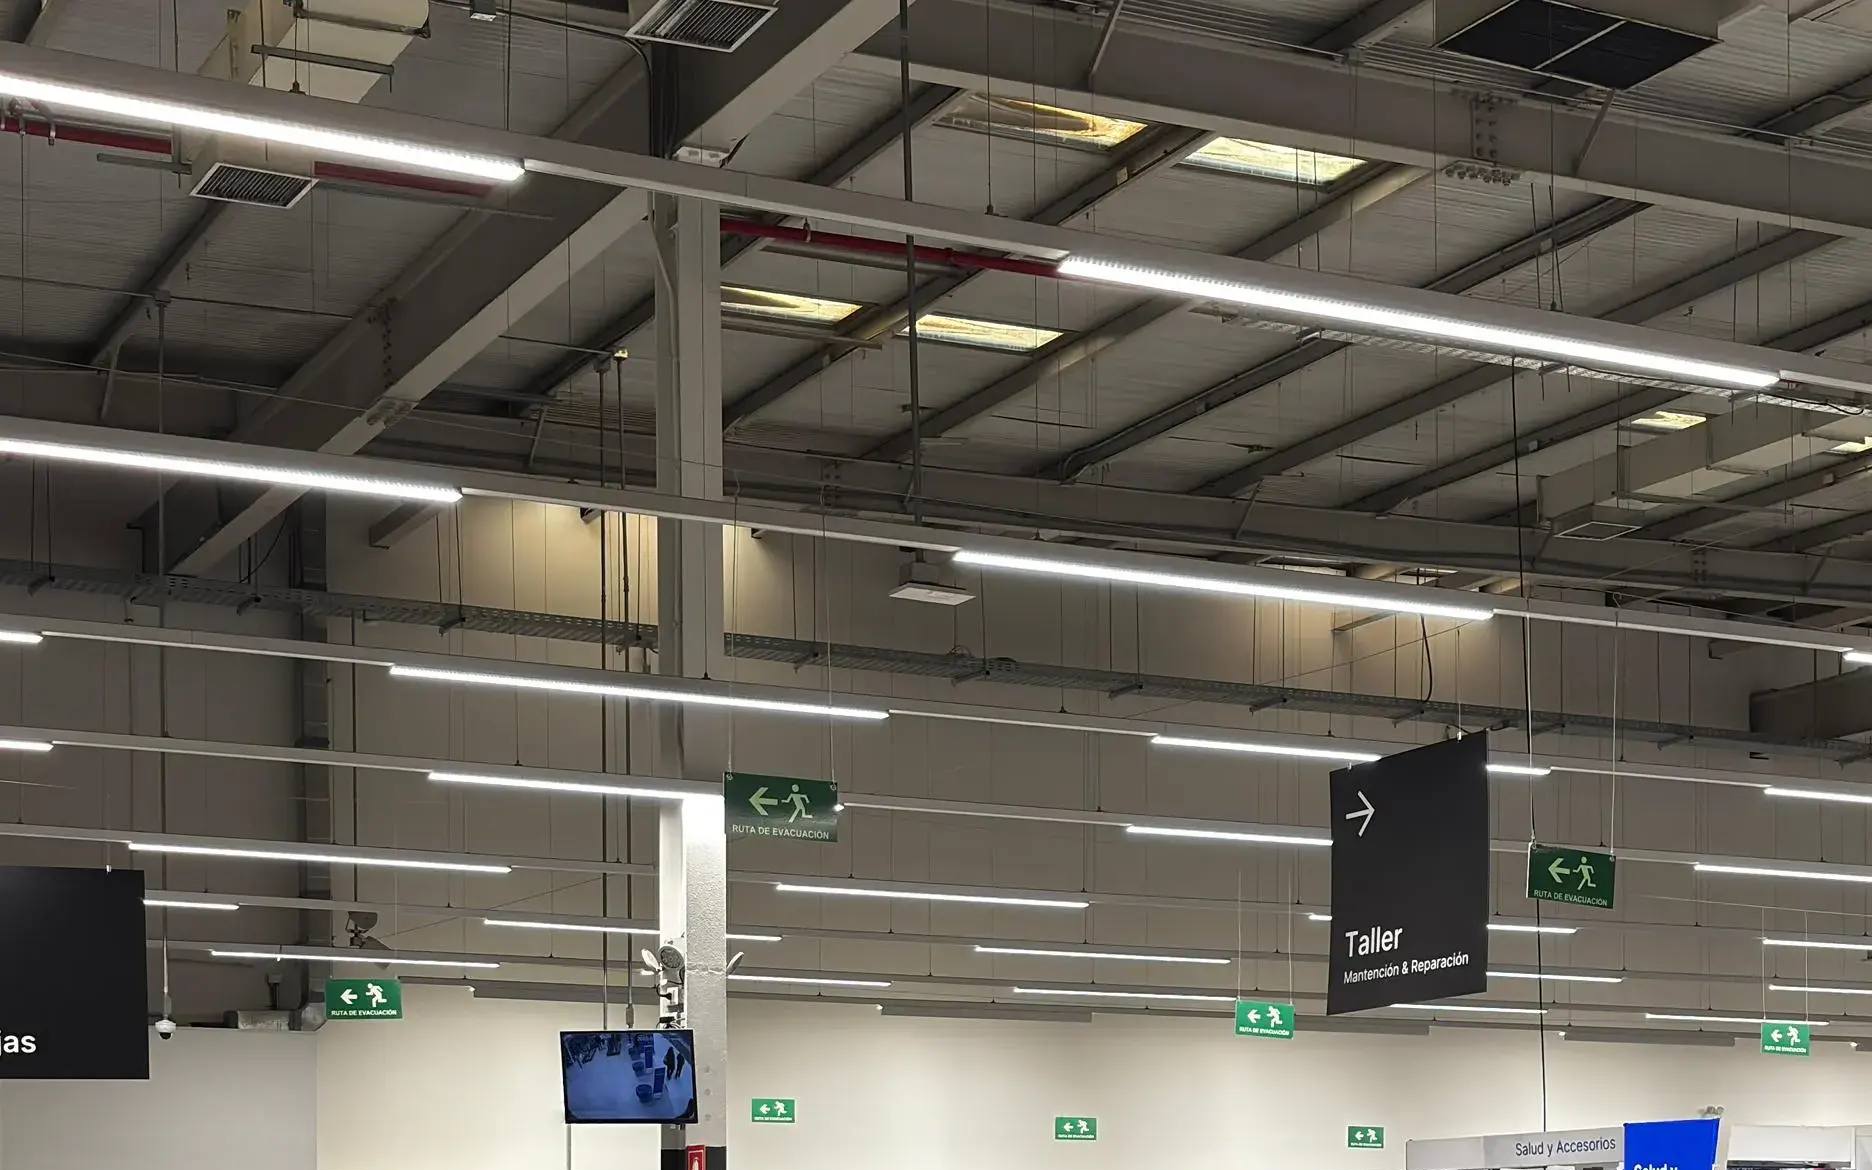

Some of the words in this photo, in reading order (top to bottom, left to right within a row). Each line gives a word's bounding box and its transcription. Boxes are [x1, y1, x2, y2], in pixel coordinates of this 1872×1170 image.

[732, 824, 755, 834] RUTA
[759, 827, 770, 835] DE
[1534, 889, 1552, 899] RUTA
[1553, 892, 1563, 900] DE
[1345, 926, 1403, 958] Taller
[1344, 962, 1400, 984] Mantención
[1402, 963, 1409, 975] &
[1411, 951, 1469, 975] Reparación
[0, 1028, 36, 1054] as
[1515, 1141, 1544, 1156] Salud
[1547, 1144, 1553, 1157] y
[1556, 1137, 1616, 1154] Accesorios
